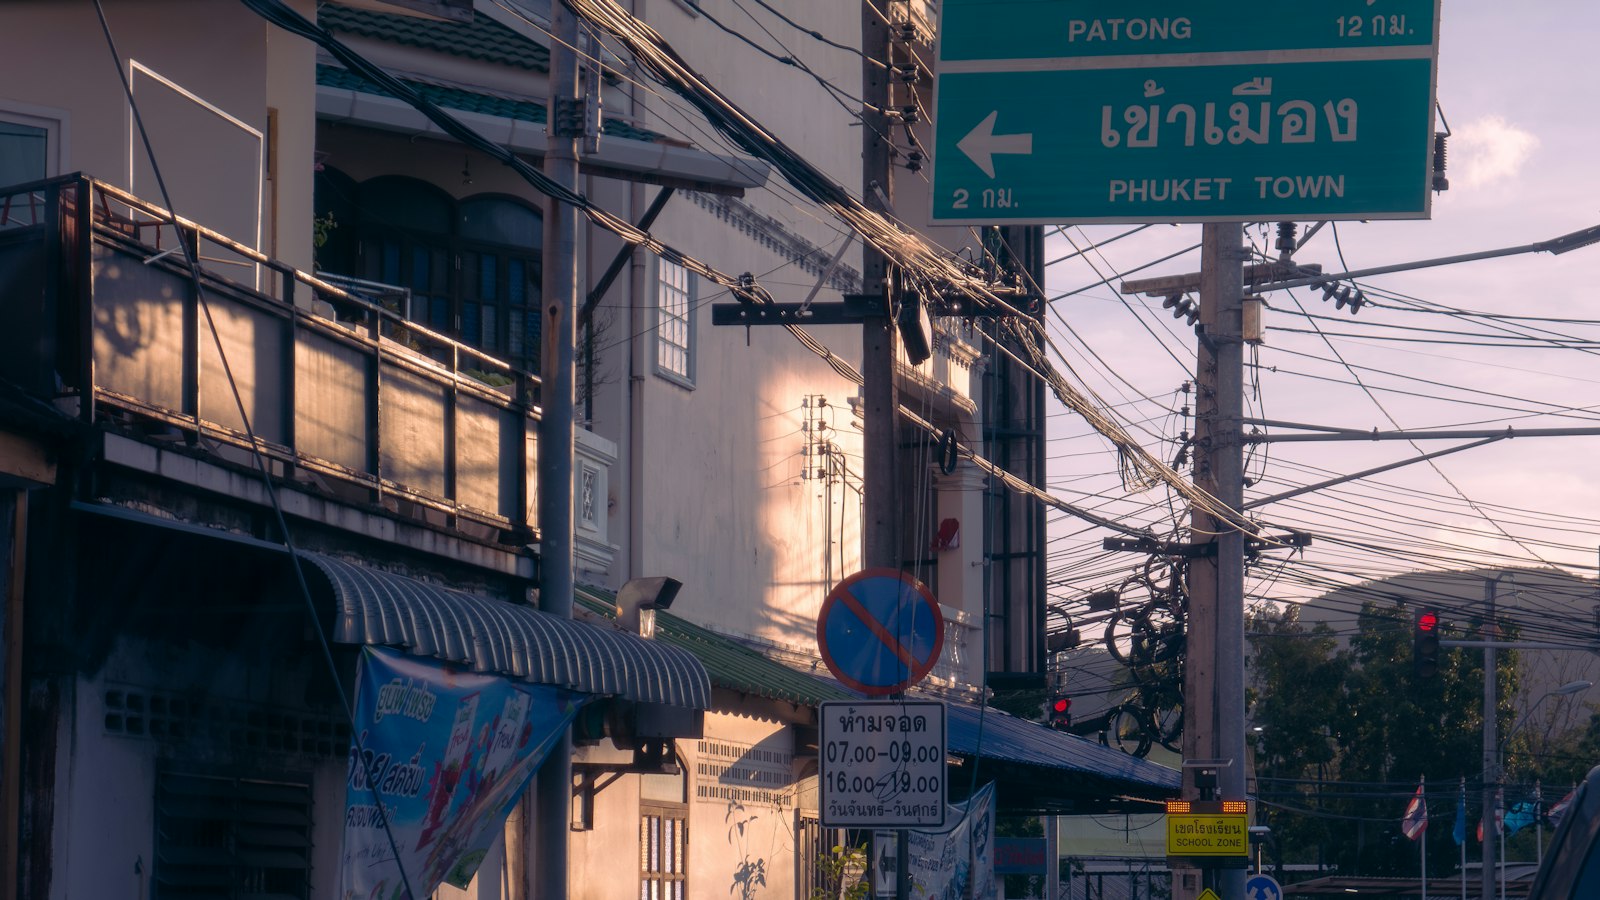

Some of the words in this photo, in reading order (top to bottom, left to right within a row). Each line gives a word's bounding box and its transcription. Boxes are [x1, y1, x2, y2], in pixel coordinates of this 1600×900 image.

[1068, 17, 1192, 42] PATONG
[1336, 16, 1363, 37] 12
[1371, 15, 1414, 36] กม.
[1101, 77, 1358, 149] เข้าเมือง
[952, 188, 969, 209] 2
[982, 187, 1018, 208] กม.
[1109, 178, 1232, 202] PHUKET
[1254, 175, 1345, 199] TOWN
[839, 707, 927, 733] ห้ามจอด
[827, 740, 939, 763] 07.00-09.00
[827, 770, 939, 793] 16.00-19.00
[829, 800, 938, 823] วันจันทร์-วันศุกร์
[1175, 819, 1242, 834] เขตโรงเรียน
[1176, 839, 1213, 847] SCHOOL
[1217, 839, 1241, 847] ZONE
